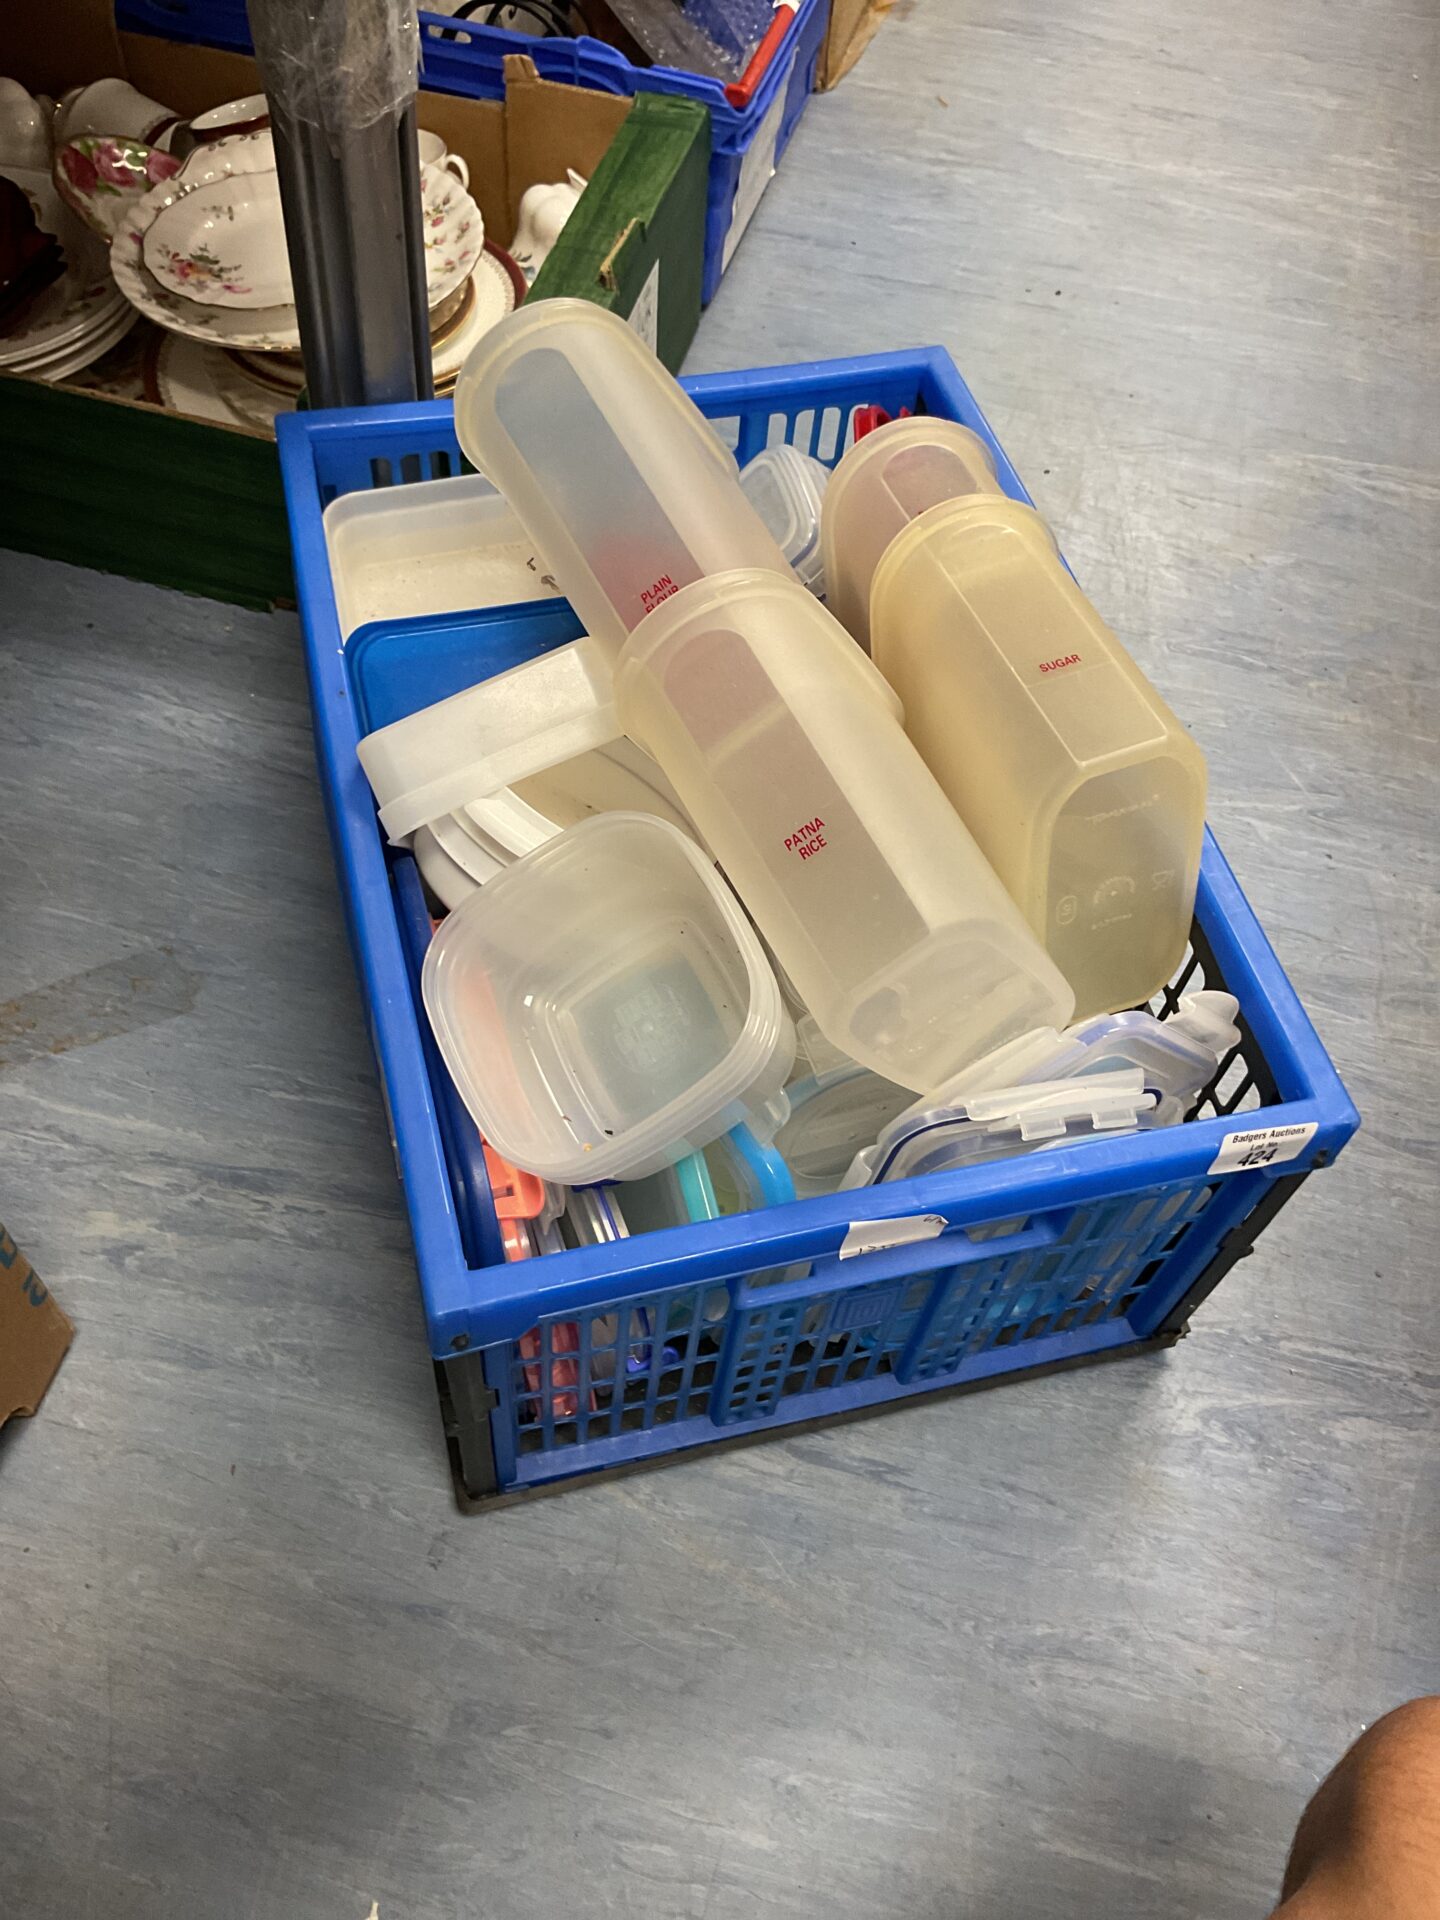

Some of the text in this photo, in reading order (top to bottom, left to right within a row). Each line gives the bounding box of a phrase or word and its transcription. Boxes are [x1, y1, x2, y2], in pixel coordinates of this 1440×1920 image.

[641, 574, 672, 604] PLAIN
[1039, 654, 1082, 673] SUGAR
[784, 817, 826, 852] PATNA
[798, 834, 828, 861] RICE
[1232, 1127, 1306, 1143] Badgers Auctions
[1237, 1148, 1279, 1167] 424
